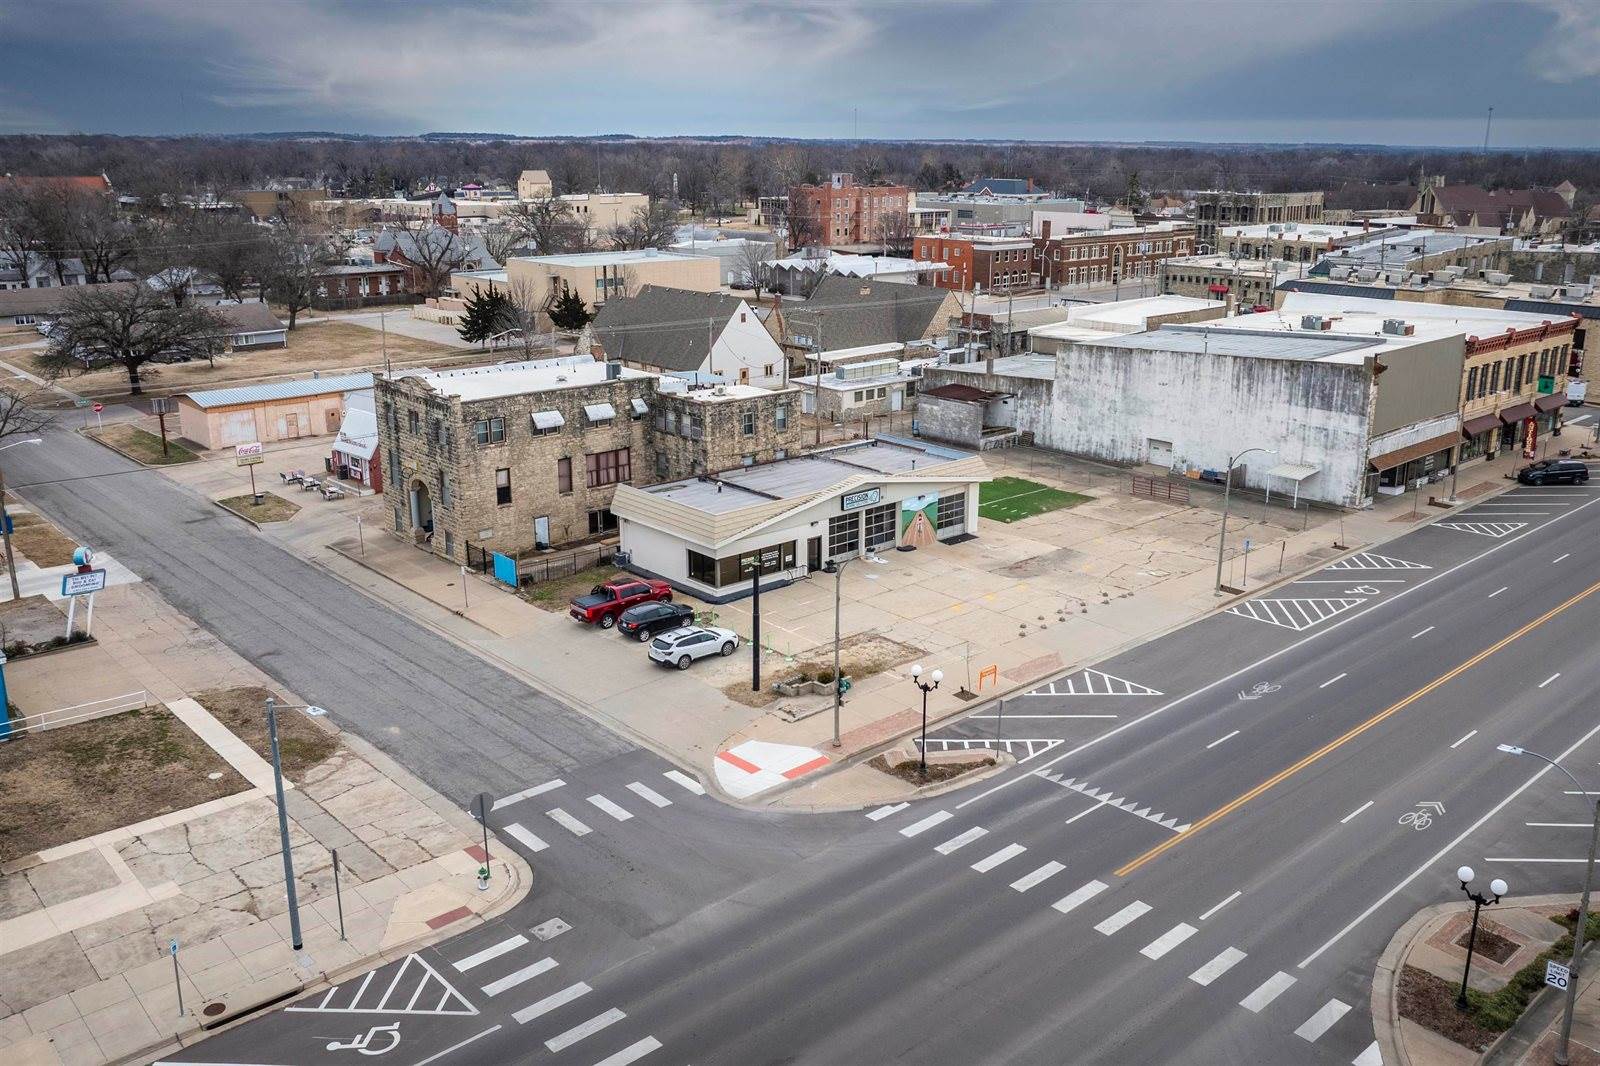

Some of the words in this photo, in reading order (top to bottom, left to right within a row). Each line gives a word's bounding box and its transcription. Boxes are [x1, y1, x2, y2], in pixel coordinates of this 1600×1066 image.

[845, 492, 869, 505] PRECISION
[1549, 962, 1568, 974] SPEED
[1550, 969, 1565, 977] LIMIT
[1546, 974, 1567, 987] 20
